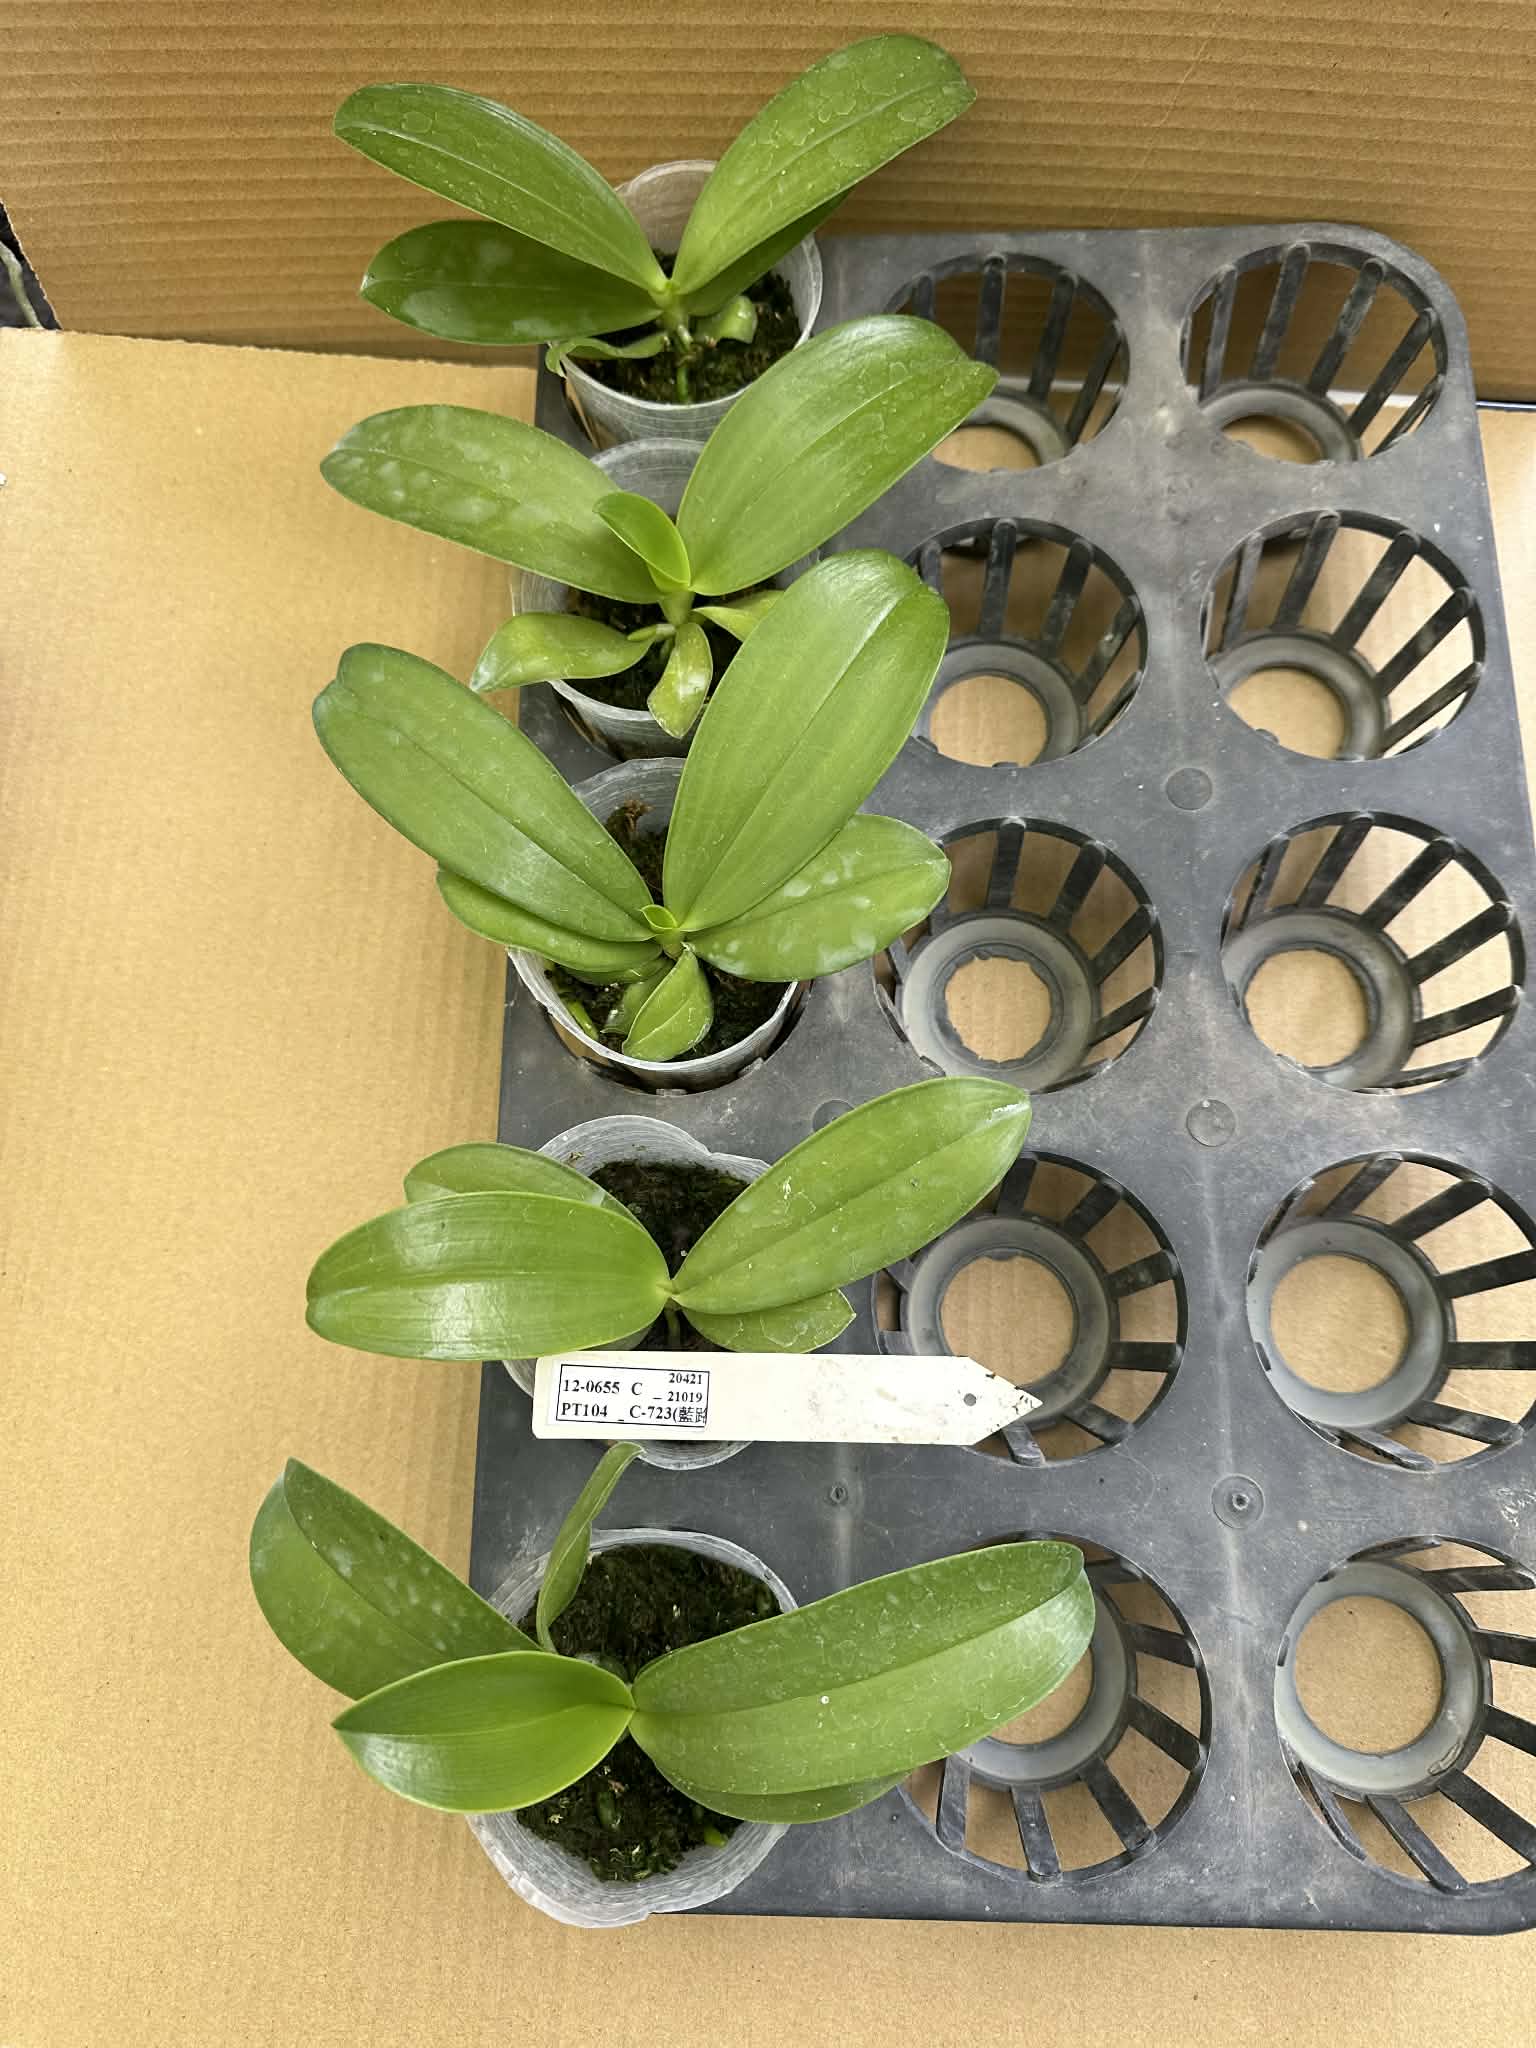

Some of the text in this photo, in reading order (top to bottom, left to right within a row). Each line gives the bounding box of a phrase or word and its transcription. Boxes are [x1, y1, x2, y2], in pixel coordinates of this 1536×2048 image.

[668, 1372, 702, 1385] 20421
[563, 1379, 643, 1396] 12-0655 C
[667, 1390, 703, 1403] 21019
[561, 1402, 608, 1417] PT104
